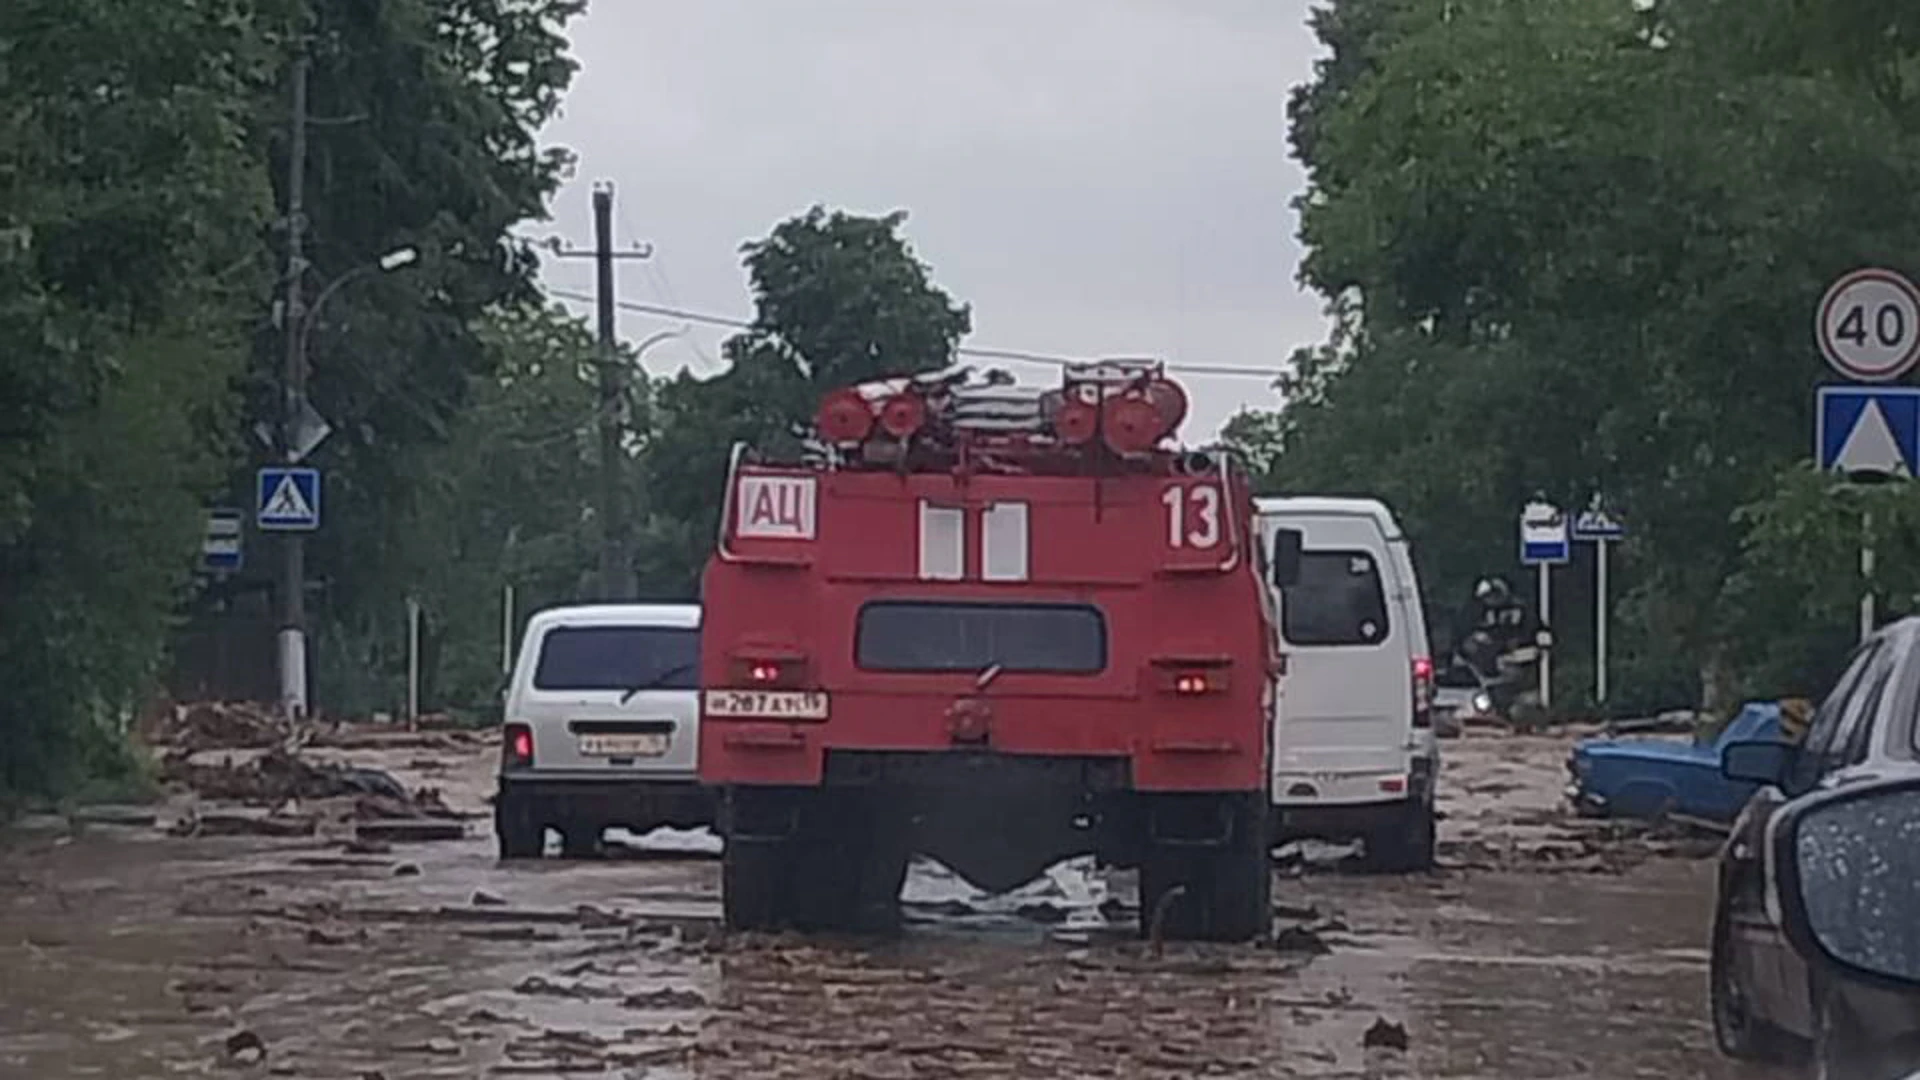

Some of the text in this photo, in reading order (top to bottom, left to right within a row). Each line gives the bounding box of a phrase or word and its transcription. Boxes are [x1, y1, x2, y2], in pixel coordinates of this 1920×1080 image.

[1836, 304, 1904, 347] 40
[750, 483, 803, 533] АЦ
[1162, 486, 1219, 548] 13
